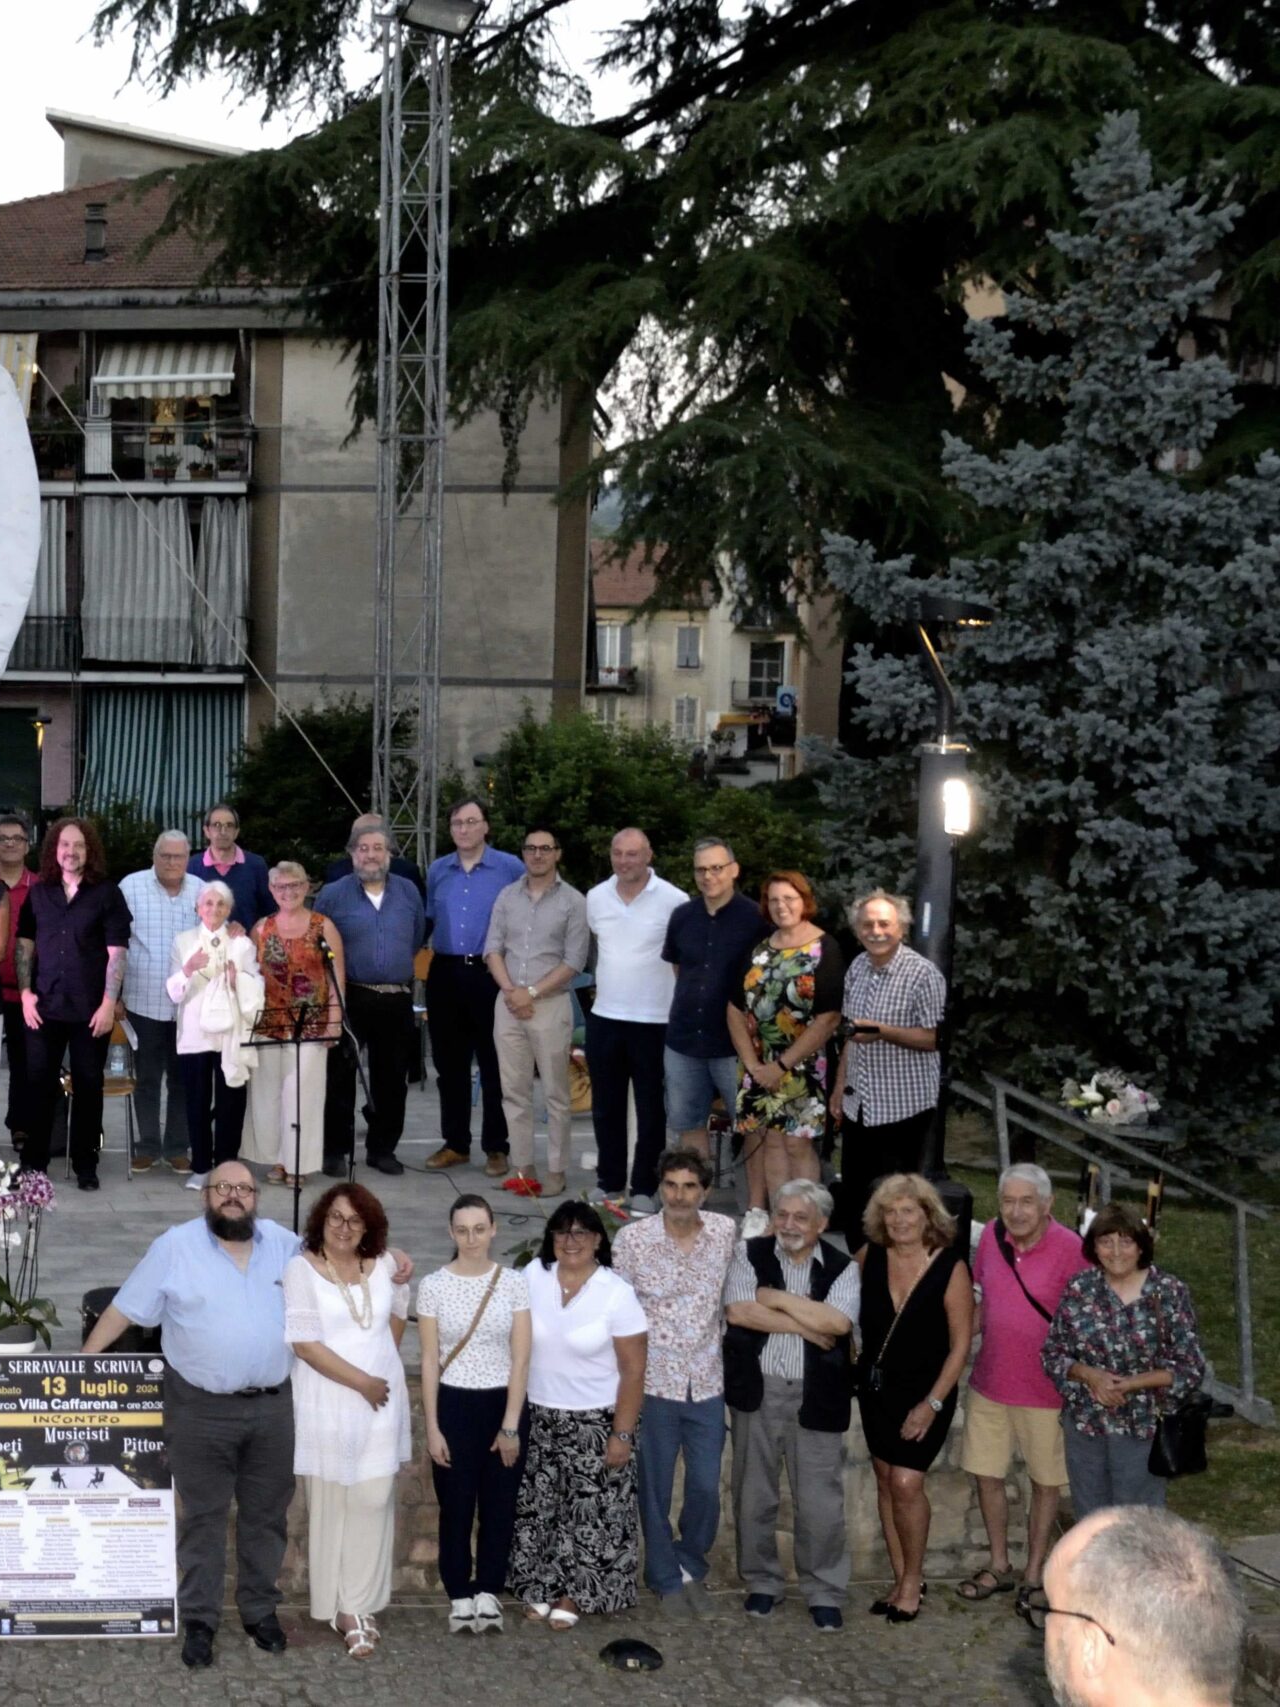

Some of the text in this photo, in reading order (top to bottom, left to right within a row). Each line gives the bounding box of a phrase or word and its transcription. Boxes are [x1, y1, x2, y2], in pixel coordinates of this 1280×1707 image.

[8, 1359, 144, 1374] SERRAVALLE SCRIVIA
[41, 1376, 67, 1396] 13
[80, 1380, 129, 1397] luglio
[135, 1384, 159, 1394] 2024
[18, 1398, 48, 1410] Villa
[51, 1398, 118, 1410] Caffarena
[126, 1402, 141, 1410] ore
[44, 1427, 110, 1444] Musicisti
[123, 1437, 165, 1454] Pittor
